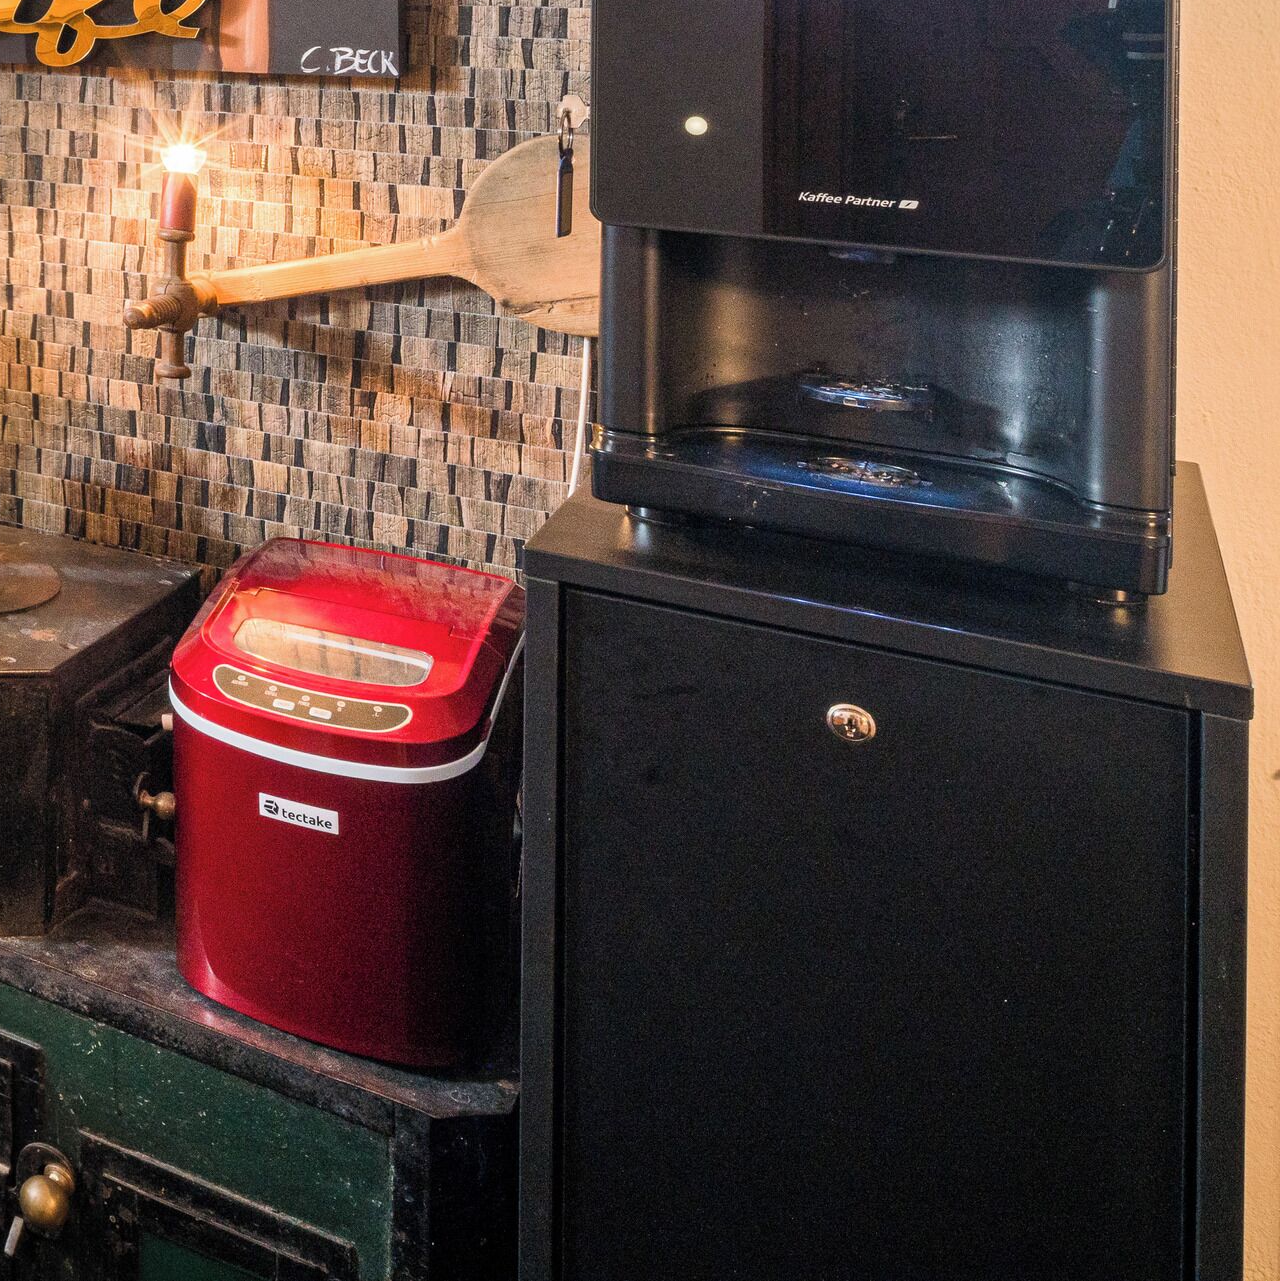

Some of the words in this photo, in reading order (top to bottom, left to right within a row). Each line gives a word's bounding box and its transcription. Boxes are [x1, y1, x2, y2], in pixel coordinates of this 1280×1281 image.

[798, 191, 843, 204] Kaffee
[844, 195, 897, 208] Partner
[281, 808, 333, 830] tectake
